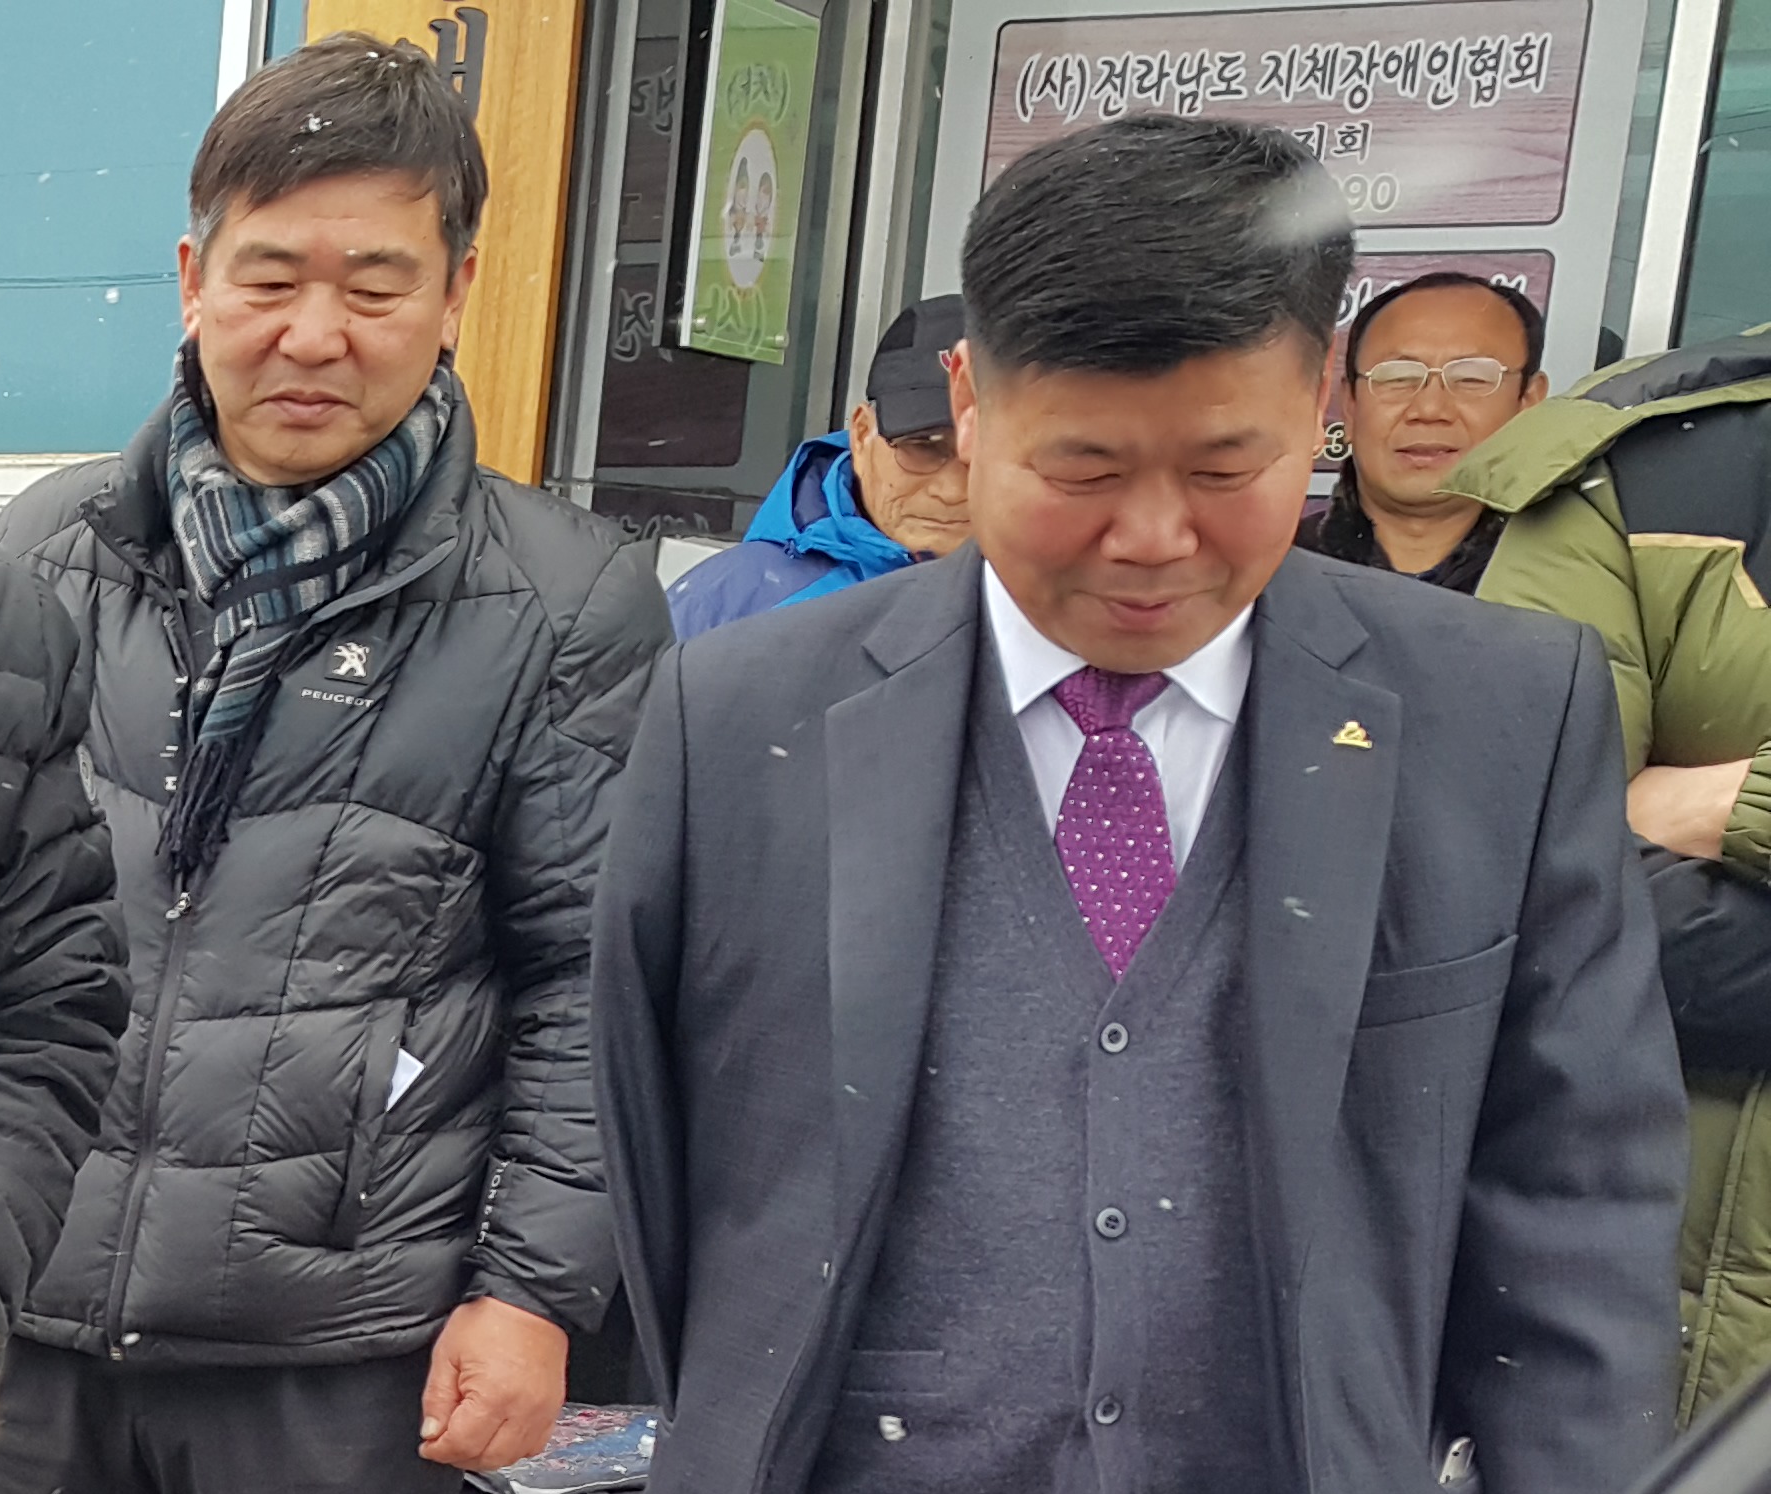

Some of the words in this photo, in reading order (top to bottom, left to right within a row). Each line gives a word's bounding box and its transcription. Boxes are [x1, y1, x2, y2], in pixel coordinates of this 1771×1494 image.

[1018, 51, 1246, 122] (사)전라남도
[1257, 34, 1550, 111] 지체장애인협회
[301, 688, 375, 708] PEUGEOT
